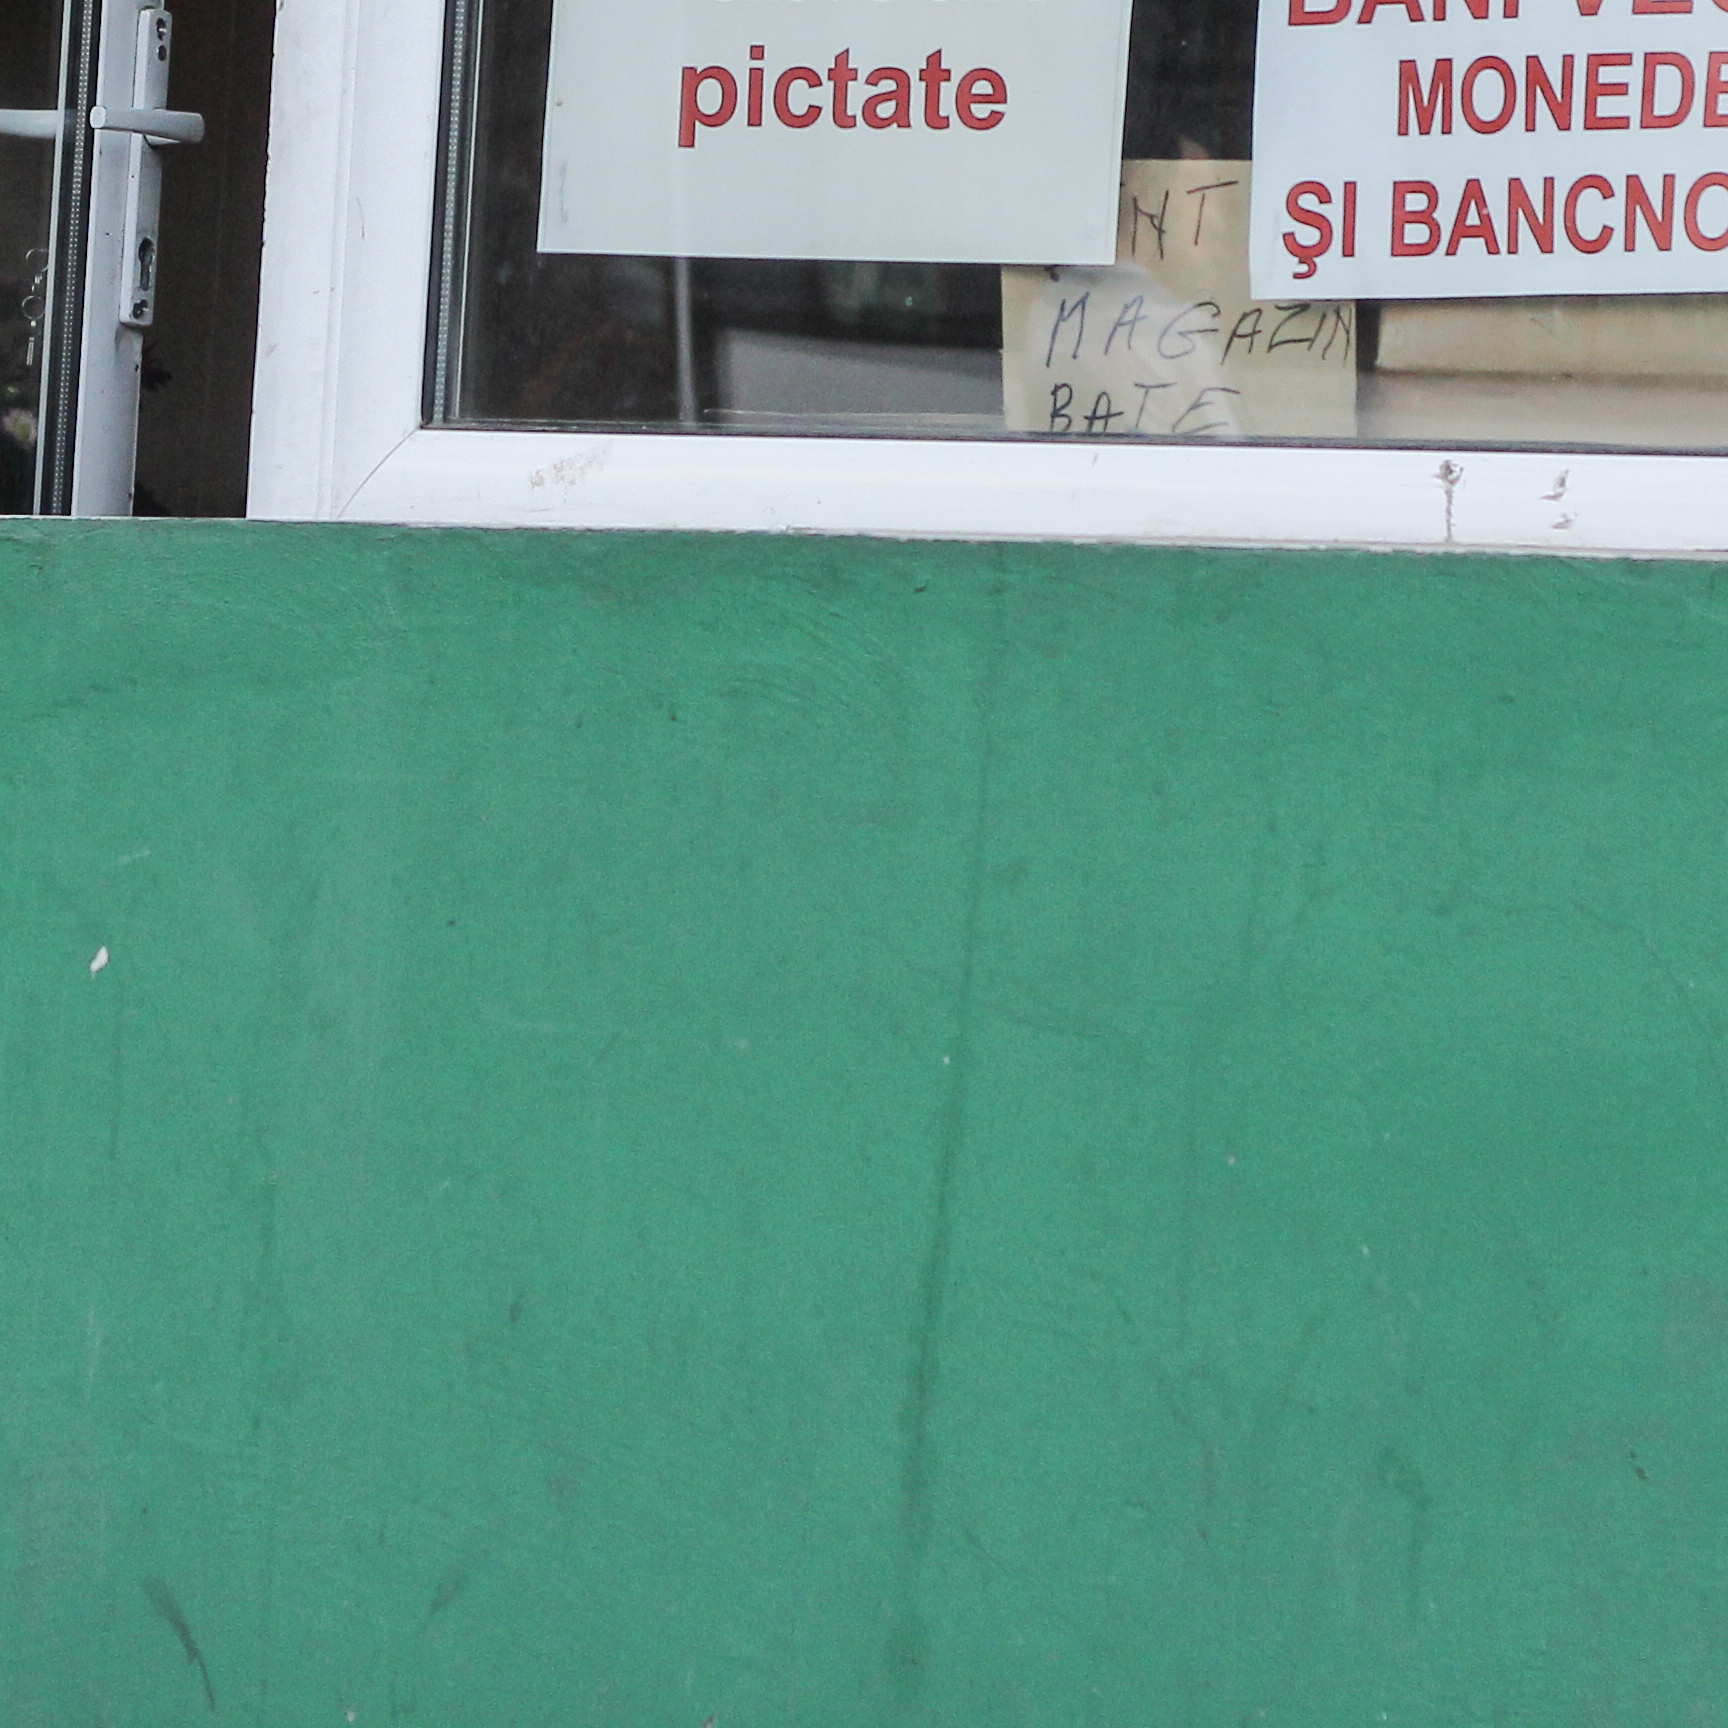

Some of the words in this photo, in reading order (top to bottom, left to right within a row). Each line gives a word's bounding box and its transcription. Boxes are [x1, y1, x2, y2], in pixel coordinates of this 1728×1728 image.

[678, 45, 1008, 148] pictate
[1281, 180, 1358, 279] ŞI
[1046, 291, 1353, 368] MAGAZIN
